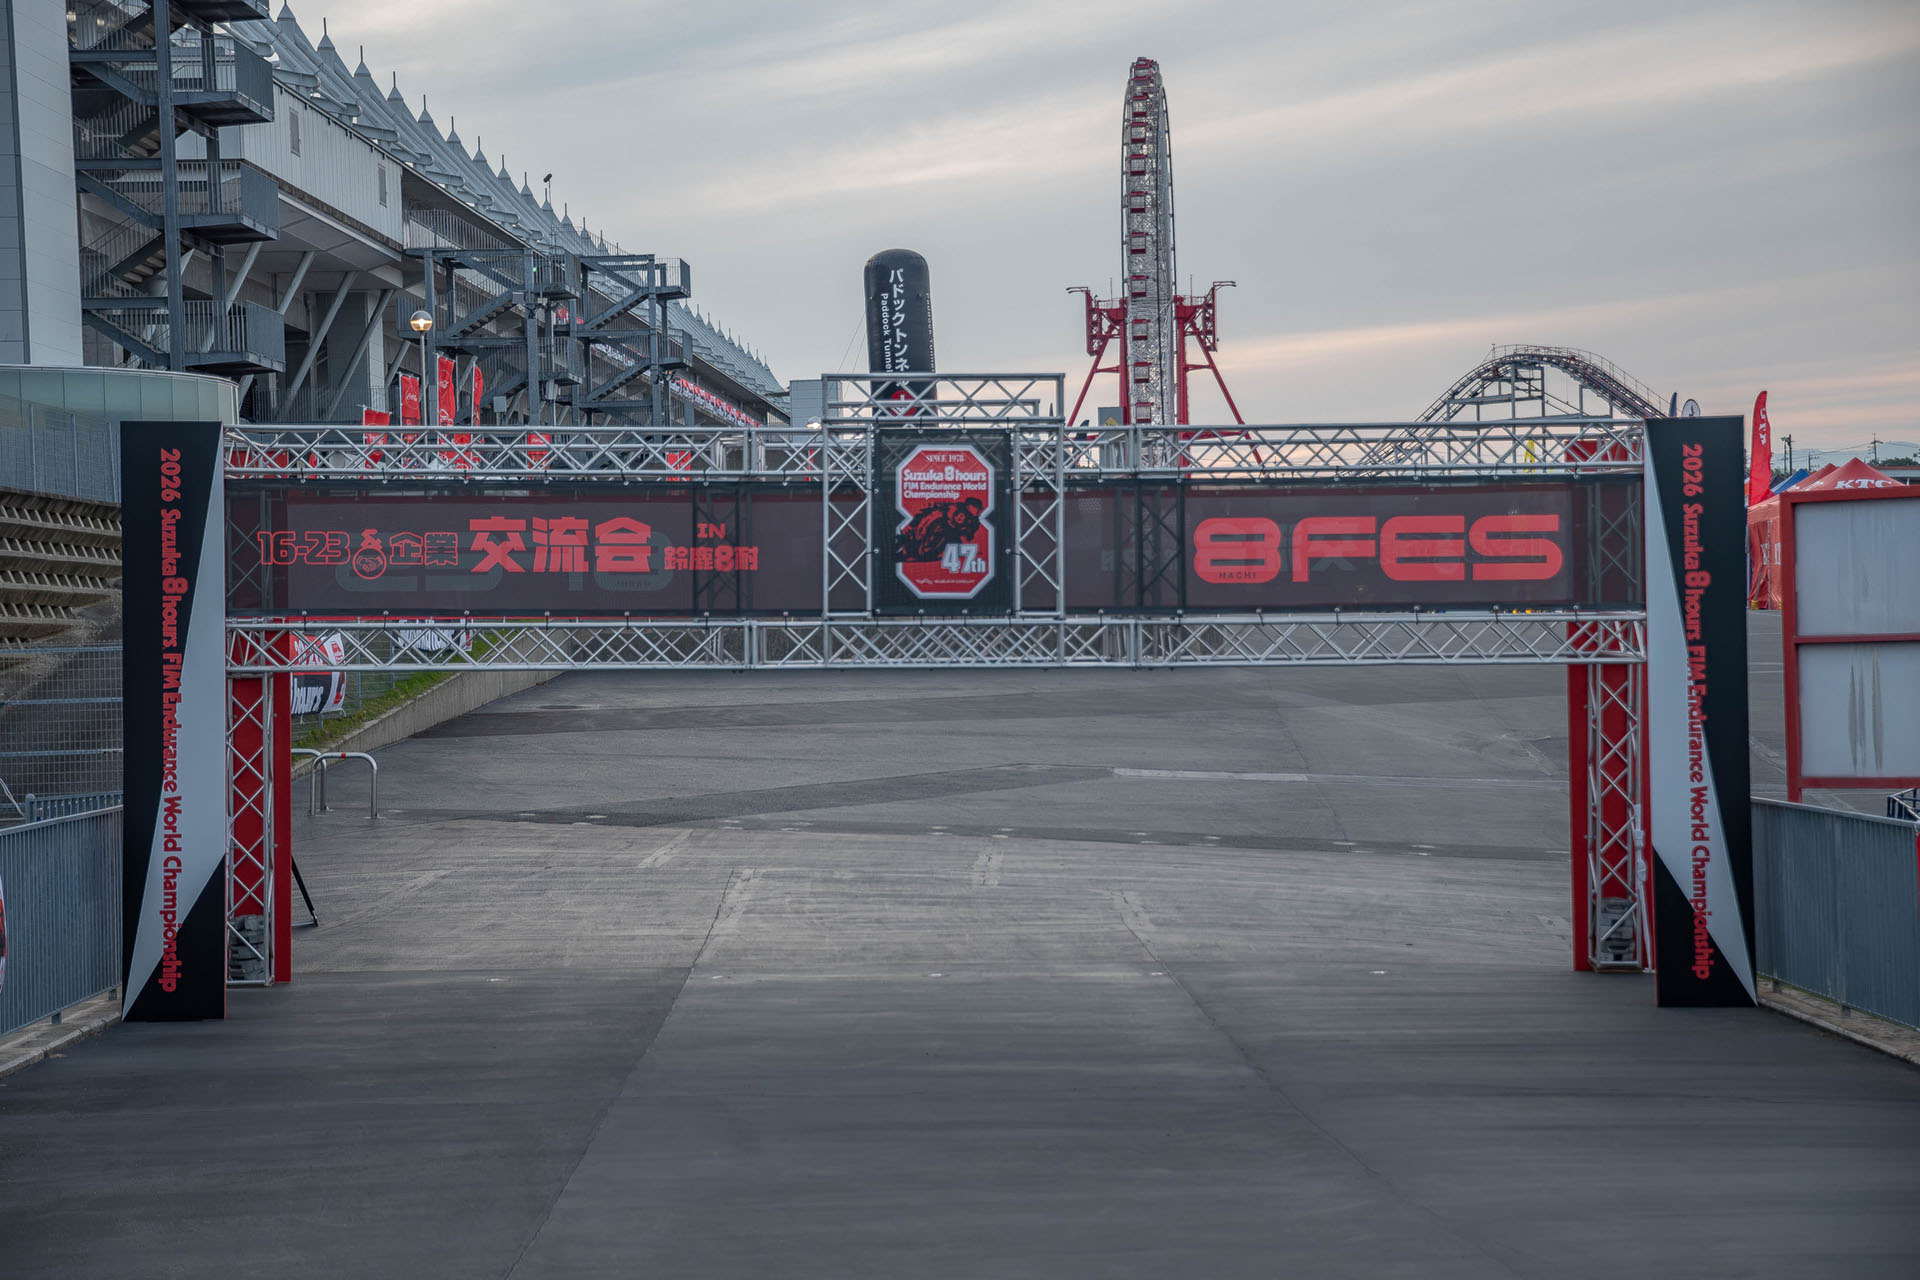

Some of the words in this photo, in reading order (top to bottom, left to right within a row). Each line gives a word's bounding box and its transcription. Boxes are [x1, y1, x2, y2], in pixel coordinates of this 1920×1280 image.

[880, 292, 890, 336] Paddock
[883, 338, 894, 373] Tunnel
[160, 447, 182, 503] 2026
[903, 468, 943, 481] Suzuka
[944, 465, 955, 481] 8
[955, 470, 986, 481] hours
[903, 482, 919, 490] FIM
[920, 482, 962, 490] Endurance
[963, 482, 986, 490] World
[1682, 443, 1704, 497] 2026
[1835, 478, 1893, 489] KTC
[903, 490, 960, 500] Championship
[160, 508, 182, 576] Suzuka
[257, 530, 351, 566] 16-23
[389, 531, 459, 567] 企業
[469, 515, 652, 574] 交流会
[697, 522, 726, 540] IN
[1193, 513, 1563, 584] 8FES
[1682, 503, 1705, 570] Suzuka
[663, 545, 760, 572] 鈴鹿8耐
[940, 543, 987, 574] 47th
[1218, 571, 1258, 580] HACHI
[1684, 570, 1712, 588] 8
[162, 577, 189, 595] 8
[1685, 588, 1706, 641] hours
[162, 652, 183, 690] FIM
[1686, 645, 1706, 682] FIM
[162, 692, 182, 793] Endurance
[1687, 682, 1708, 784] Endurance
[162, 795, 182, 852] World
[1689, 786, 1710, 843] World
[158, 855, 183, 994] Championship
[1689, 845, 1715, 980] Championship
